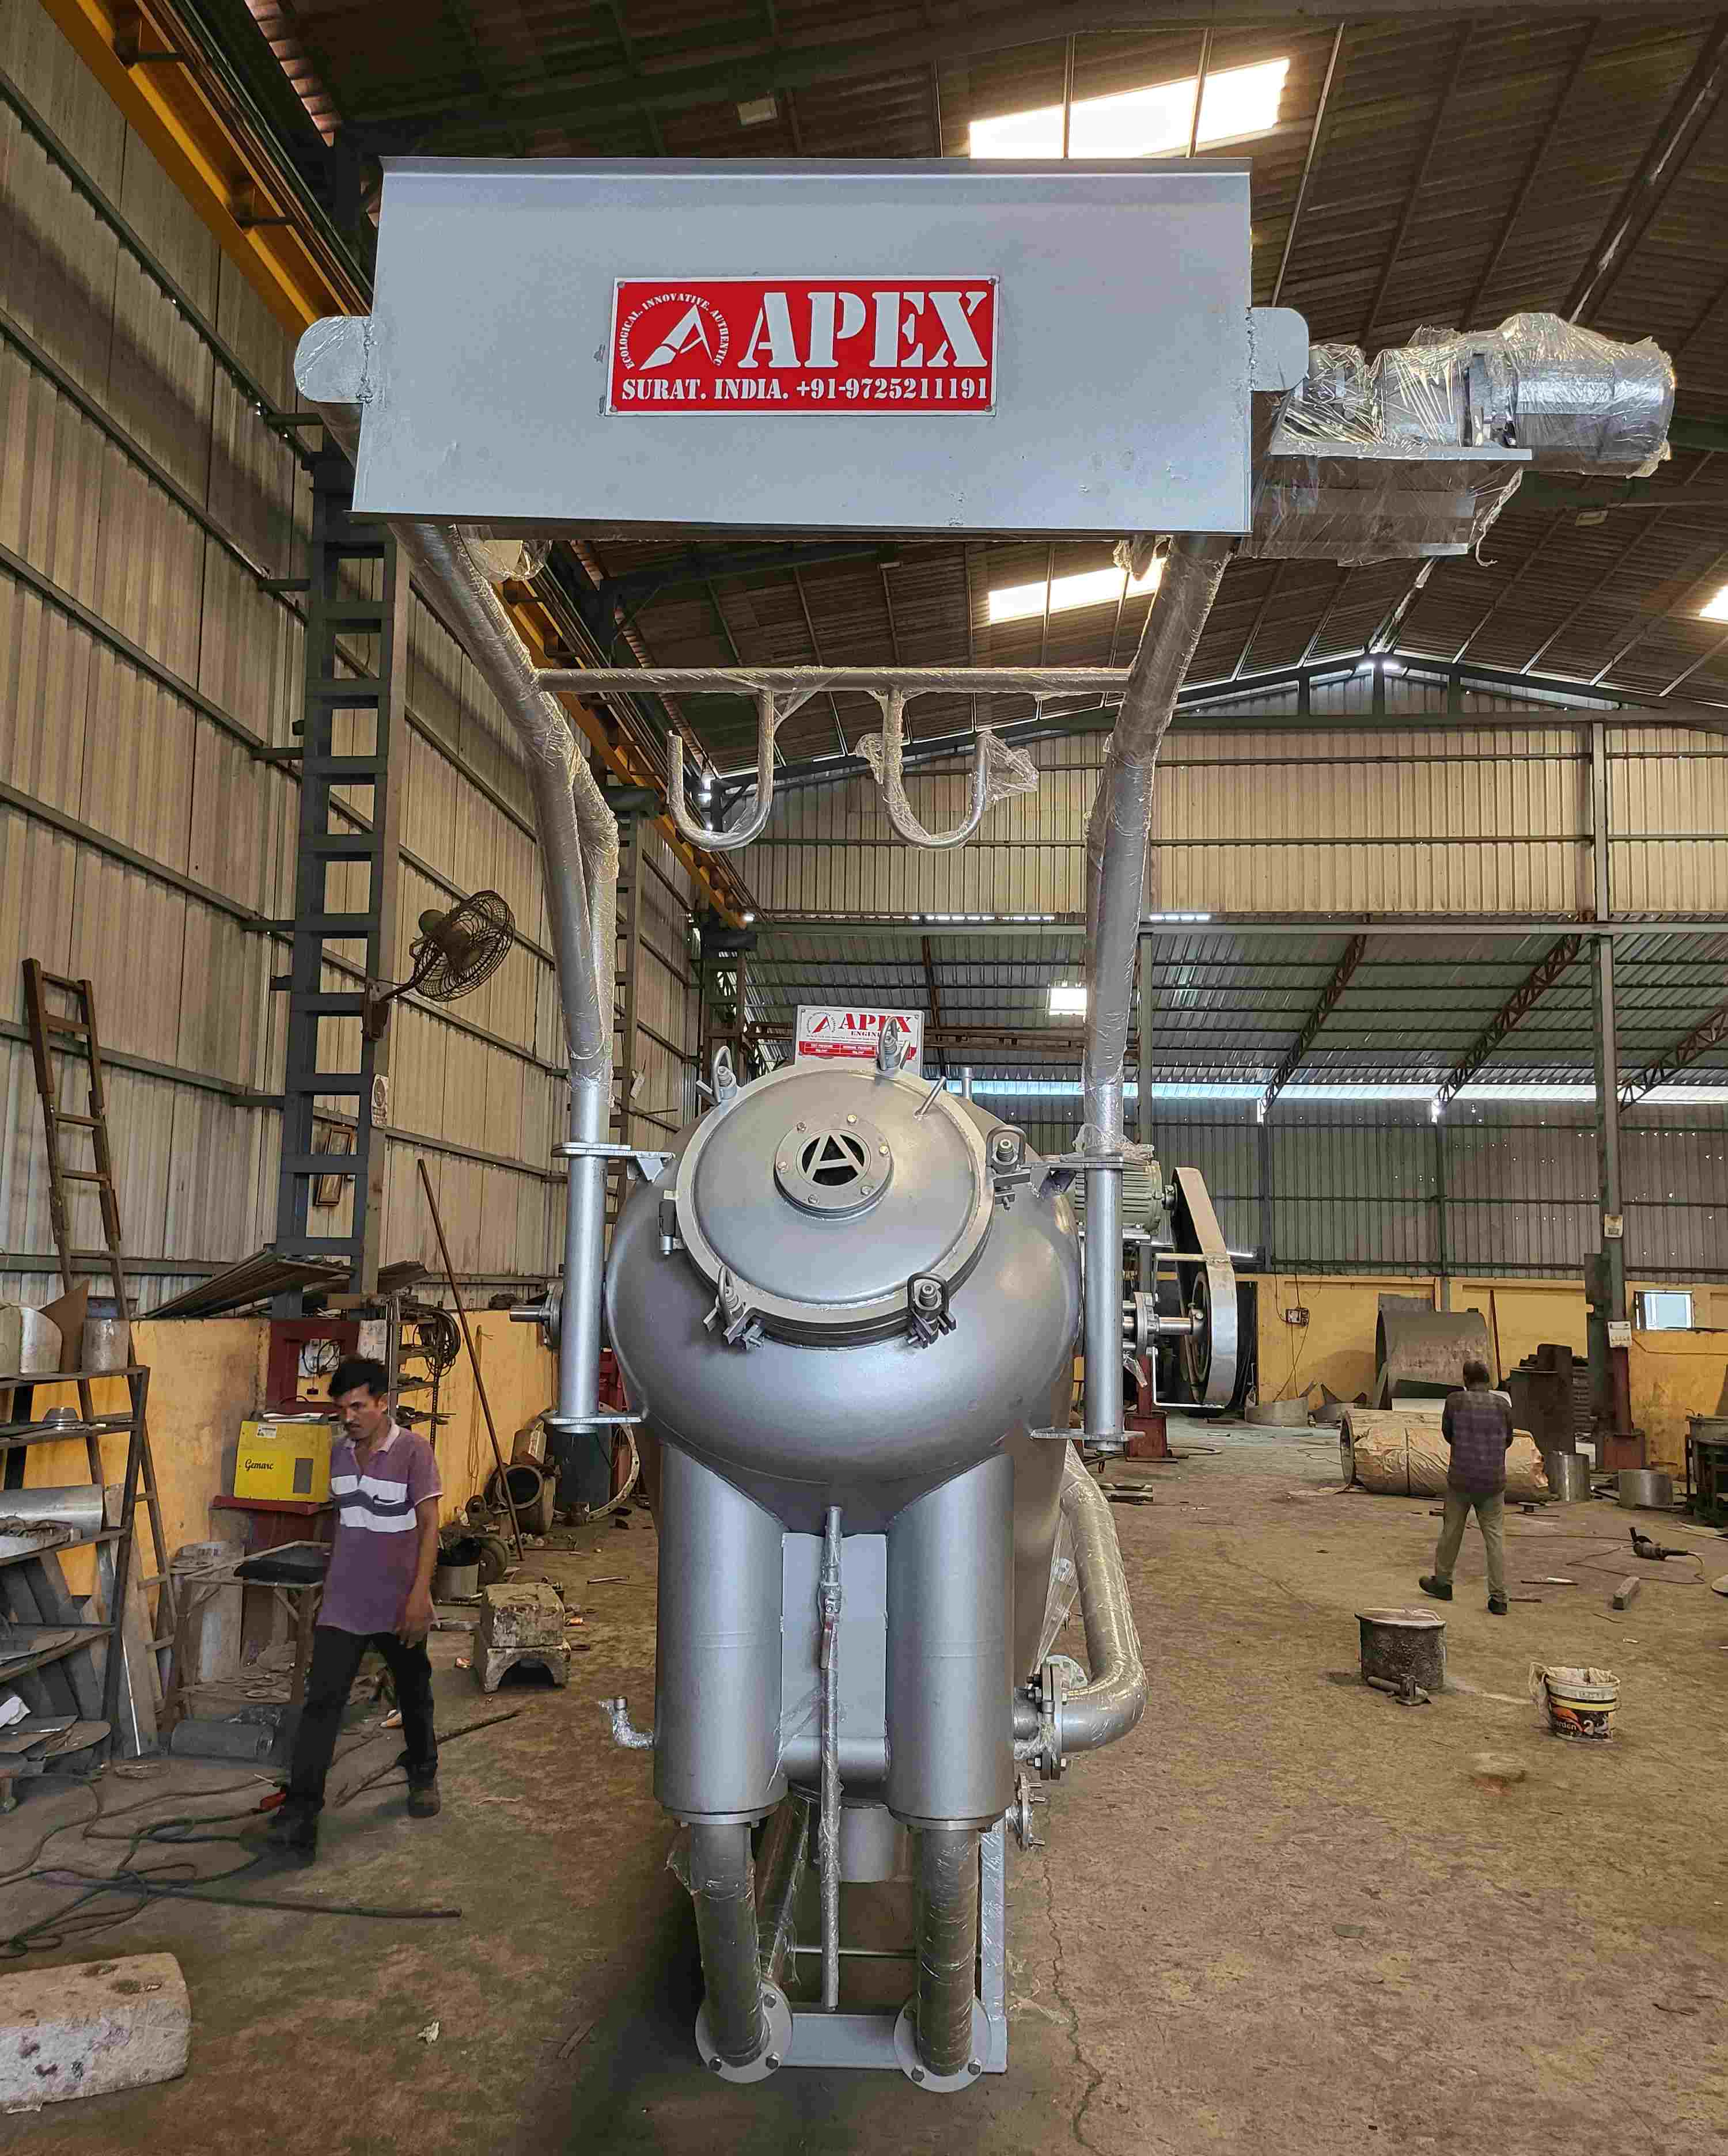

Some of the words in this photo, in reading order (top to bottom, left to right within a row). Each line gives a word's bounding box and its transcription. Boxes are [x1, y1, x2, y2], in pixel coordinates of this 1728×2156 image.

[641, 293, 710, 312] INNOVATIVE.
[709, 309, 730, 367] AUTHENTIC
[737, 291, 988, 369] APEX
[622, 378, 707, 400] SURAT.
[714, 378, 789, 400] INDIA.
[796, 378, 987, 400] +91-9725211191
